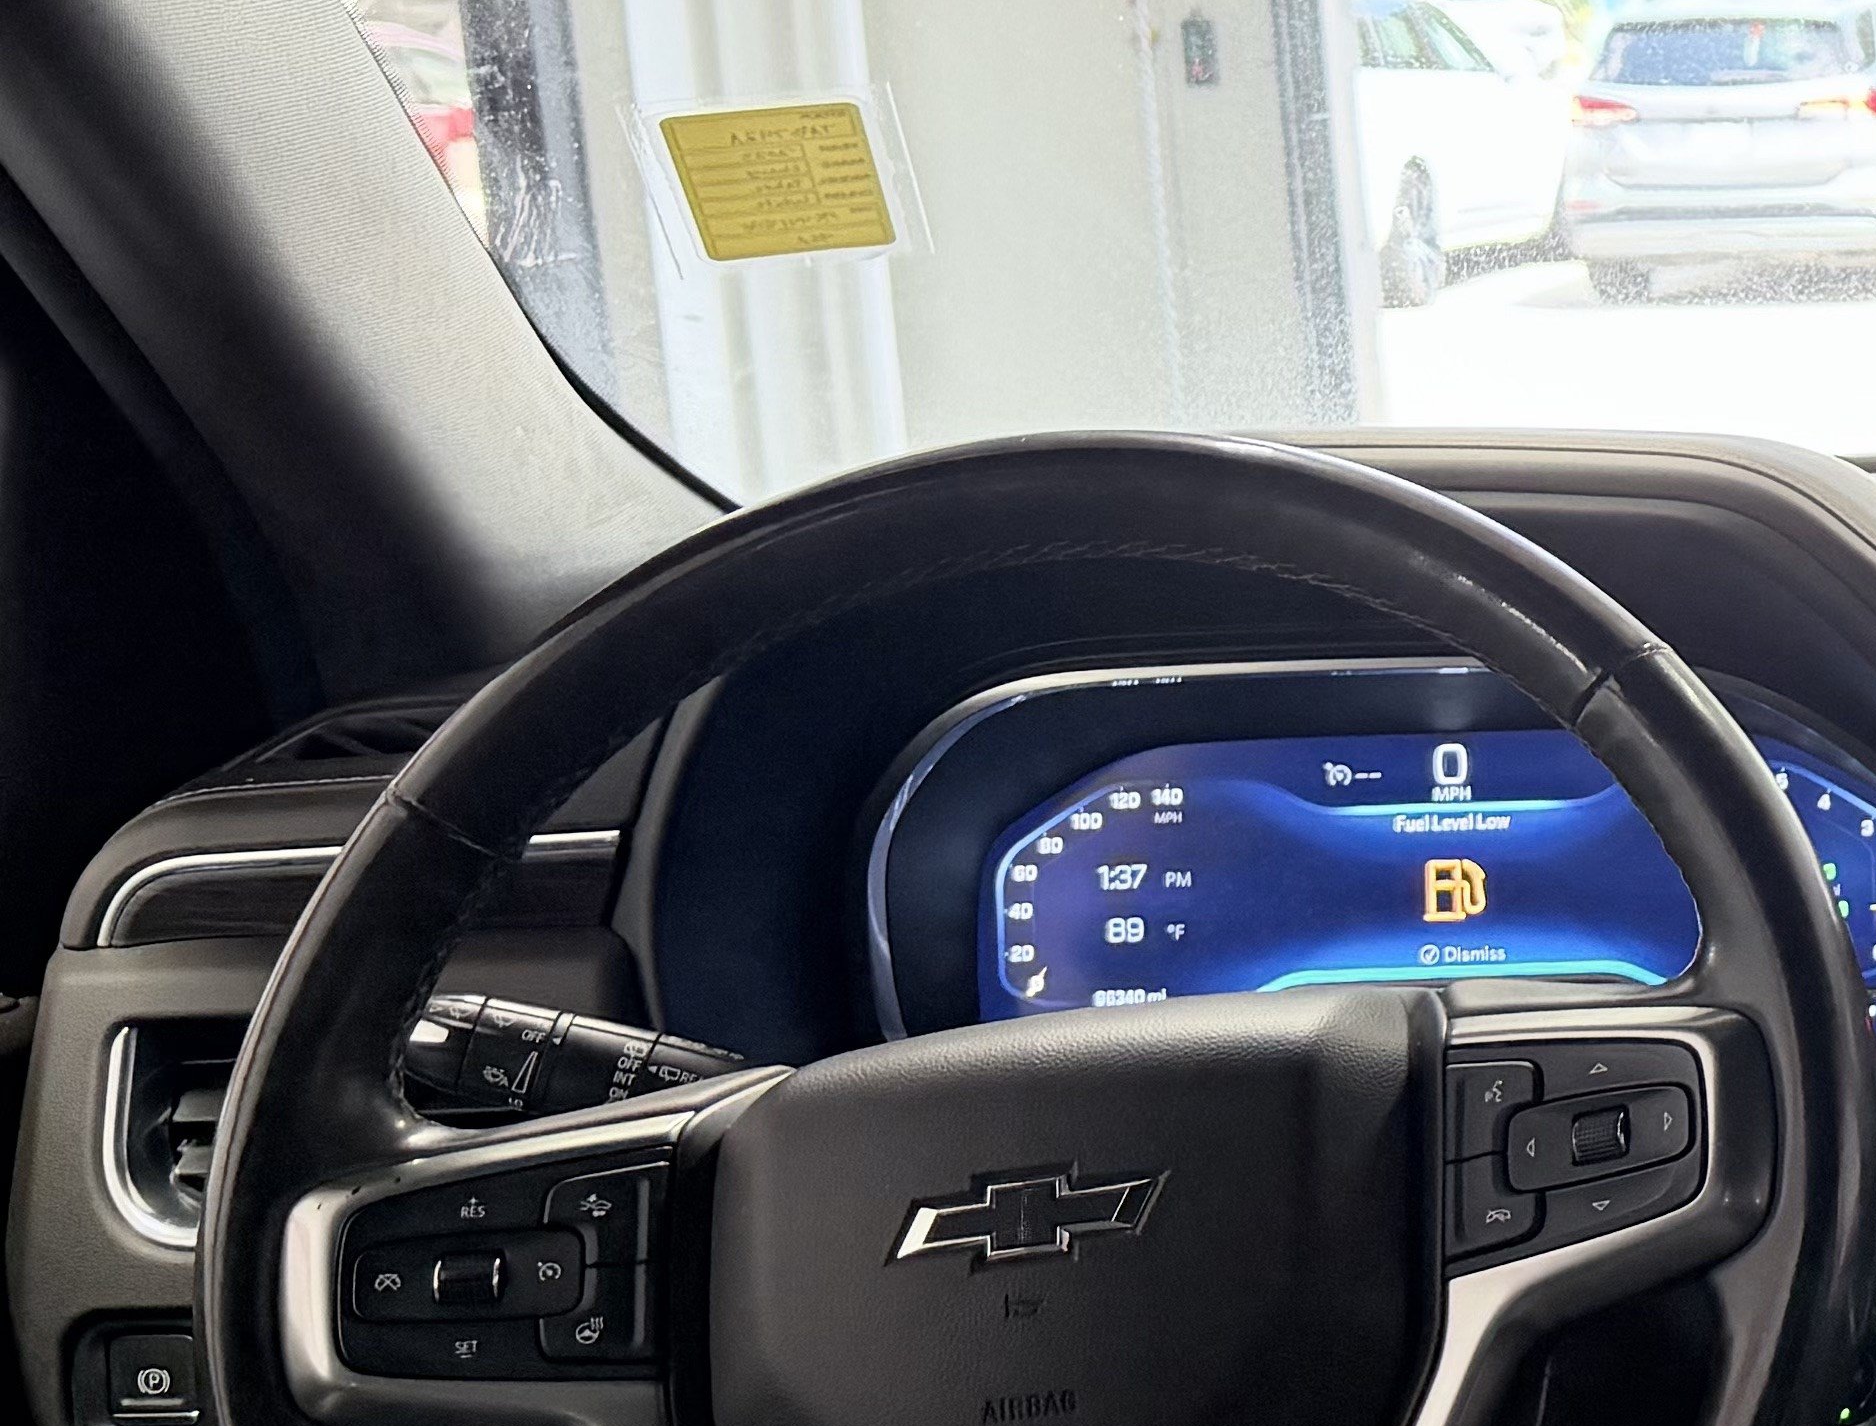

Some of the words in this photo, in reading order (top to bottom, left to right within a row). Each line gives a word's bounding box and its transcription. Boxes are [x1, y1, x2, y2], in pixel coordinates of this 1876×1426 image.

[1433, 743, 1468, 785] 0
[1109, 791, 1141, 810] 120
[1151, 788, 1183, 806] 140
[1432, 786, 1472, 802] MPH
[1070, 812, 1103, 830] 100
[1154, 811, 1183, 824] MPH
[1393, 815, 1430, 833] Fuel
[1433, 814, 1474, 832] Level
[1476, 813, 1511, 831] Low
[1861, 819, 1875, 837] 3
[1010, 864, 1039, 883] 60
[1096, 864, 1147, 891] 1:37
[1164, 870, 1192, 888] PM
[1007, 902, 1034, 920] 40
[1105, 917, 1145, 944] 89
[1009, 944, 1035, 963] 20
[1444, 946, 1507, 963] Dismiss
[1147, 987, 1167, 1002] mi
[521, 1029, 546, 1044] OFF
[617, 1056, 642, 1072] OFF
[613, 1070, 637, 1086] INT
[609, 1087, 630, 1100] ON
[460, 1205, 486, 1219] RES
[454, 1339, 478, 1354] SET
[981, 1388, 1077, 1425] AIRBAG
